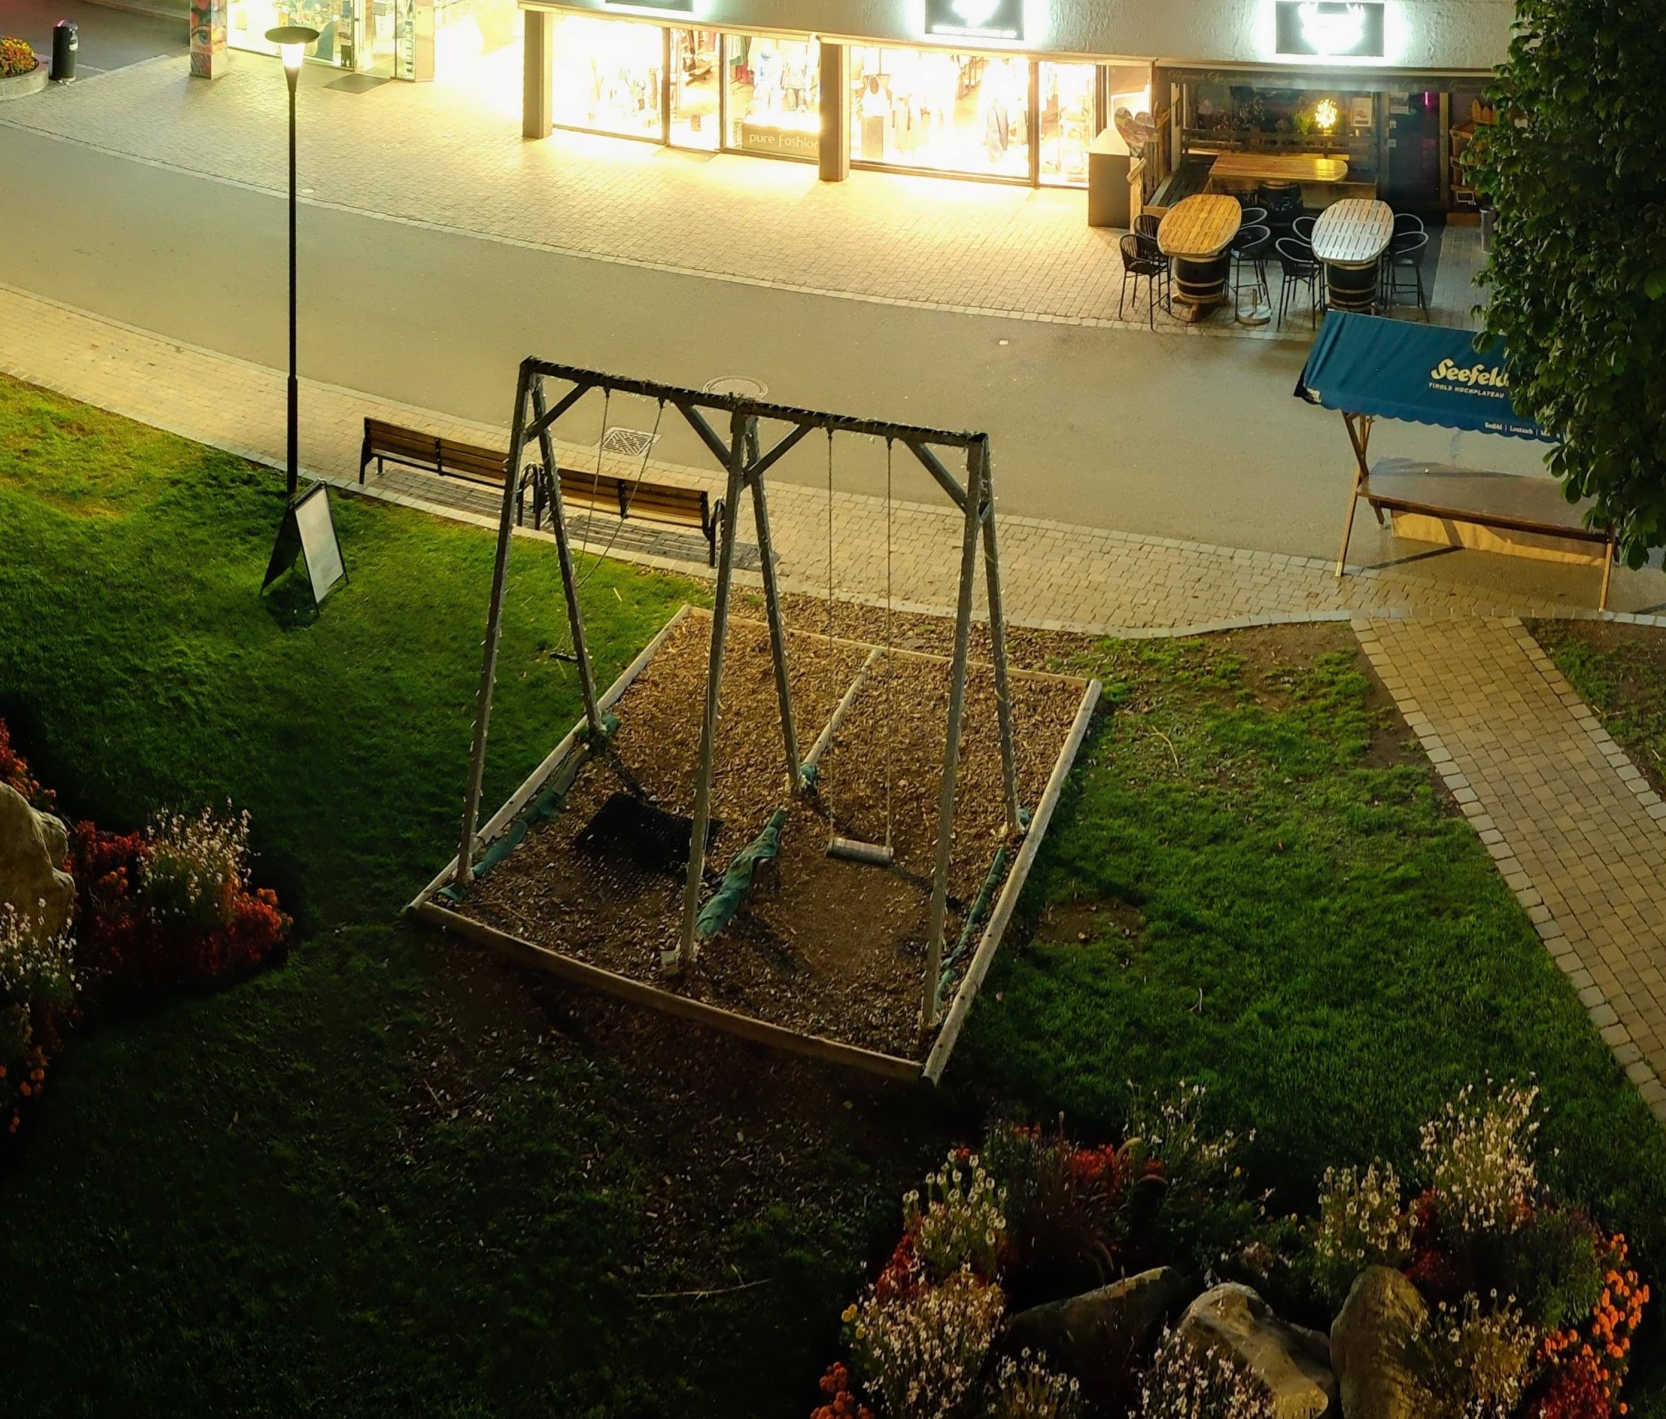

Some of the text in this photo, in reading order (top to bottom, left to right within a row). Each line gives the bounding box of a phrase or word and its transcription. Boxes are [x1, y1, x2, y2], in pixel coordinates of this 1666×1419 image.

[749, 133, 775, 145] pure
[1431, 357, 1510, 389] Seefeld
[1428, 382, 1506, 399] TIROLS HOCHPLATEAU
